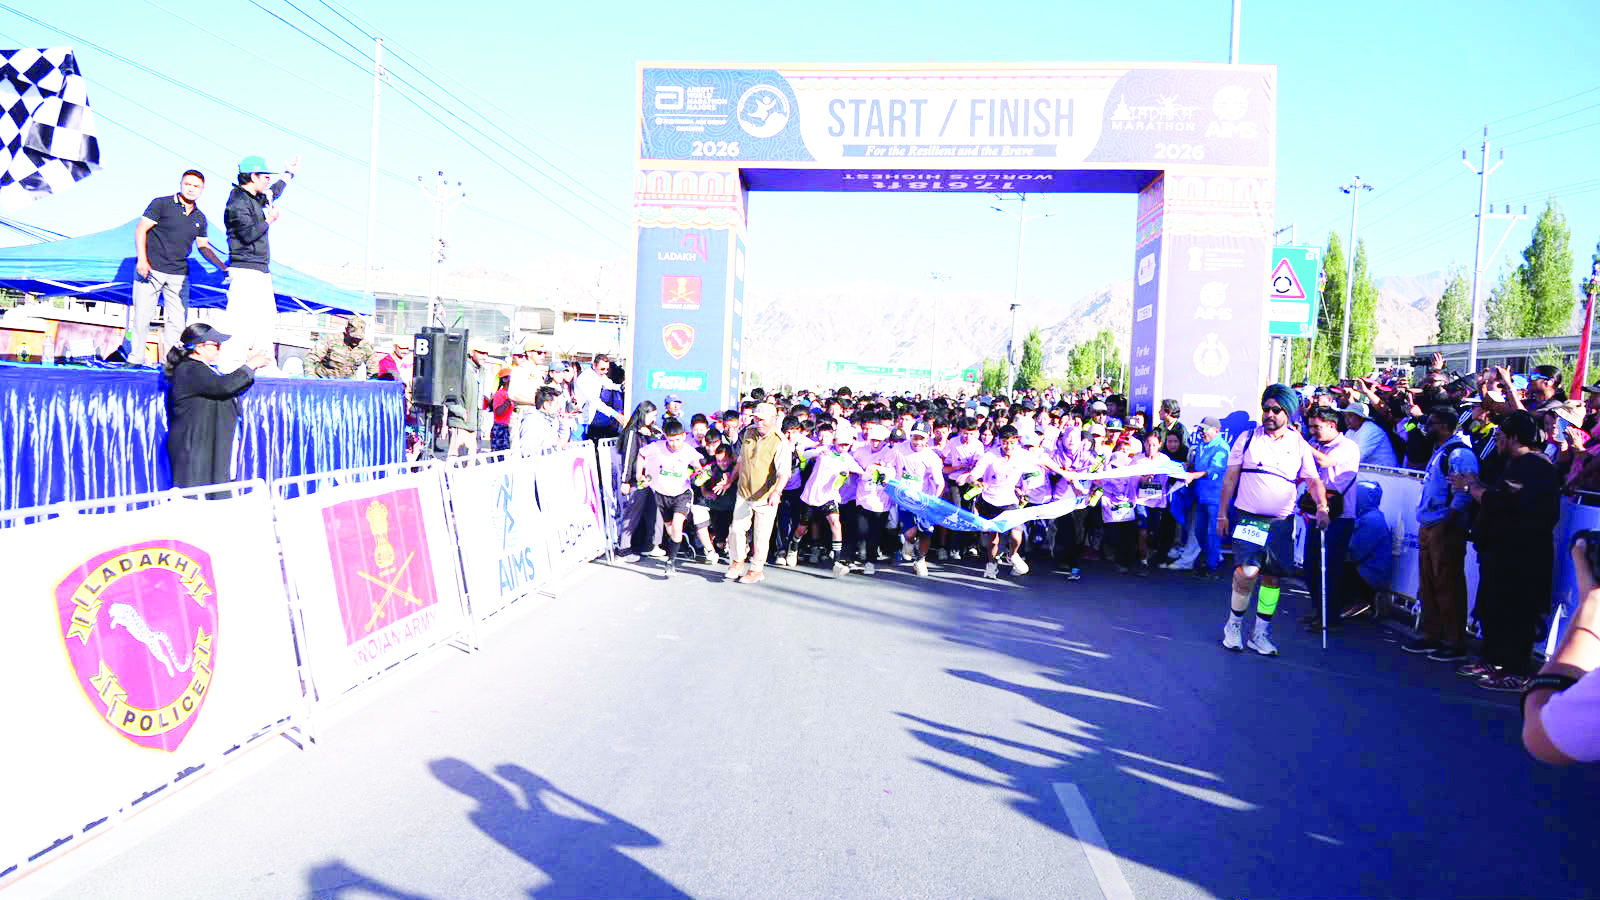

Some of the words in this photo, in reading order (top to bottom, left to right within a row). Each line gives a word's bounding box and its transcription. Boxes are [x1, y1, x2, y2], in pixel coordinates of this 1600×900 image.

[827, 98, 928, 137] START
[938, 99, 958, 137] /
[969, 98, 1074, 137] FINISH
[1112, 120, 1195, 132] MARATHON
[1205, 121, 1258, 139] AIMS
[692, 141, 740, 157] 2026
[865, 146, 887, 156] For
[888, 146, 906, 156] the
[908, 146, 956, 156] Resilient
[957, 146, 979, 156] and
[980, 146, 999, 156] the
[1001, 146, 1035, 156] Brave
[1153, 143, 1206, 160] 2026
[872, 181, 902, 190] ft
[907, 180, 1016, 190] 17,618
[657, 251, 697, 262] LADAKH
[1193, 306, 1233, 321] AIMS
[415, 338, 429, 355] B
[557, 517, 594, 554] LADAKH
[1241, 527, 1261, 538] 5156
[84, 552, 188, 595] LADAKH
[499, 547, 535, 596] AIMS
[353, 627, 401, 667] INDIAN
[405, 609, 437, 642] ARMY
[122, 680, 206, 731] POLICE
